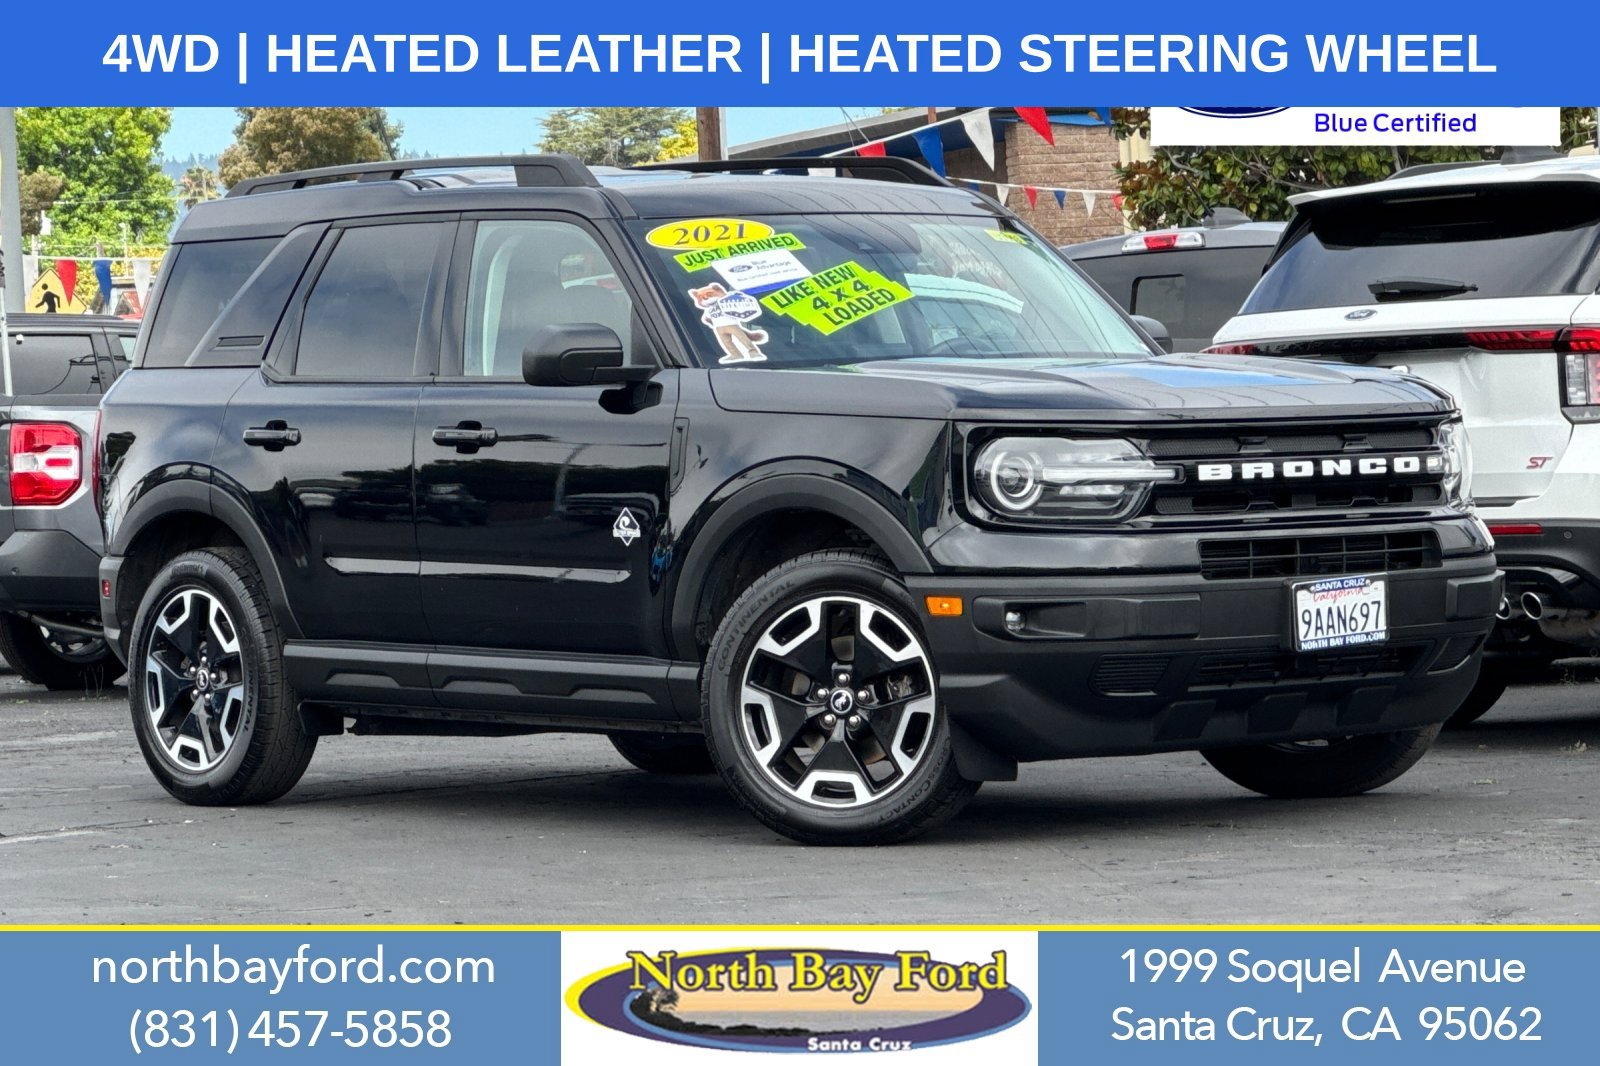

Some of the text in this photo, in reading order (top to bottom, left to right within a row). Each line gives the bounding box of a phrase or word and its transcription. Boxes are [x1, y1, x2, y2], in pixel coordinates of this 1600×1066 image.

[673, 223, 748, 246] 2021
[684, 235, 797, 267] JUST ARRIVED
[770, 281, 817, 309] LIKE
[812, 264, 857, 289] NEW
[812, 296, 832, 310] 4
[852, 279, 872, 293] 4
[823, 288, 896, 326] LOADED
[1197, 456, 1421, 481] BRONCO
[1526, 456, 1554, 470] ST
[1312, 586, 1370, 603] California
[1315, 577, 1366, 592] SANTA CRUZ
[1301, 600, 1381, 639] 9AAN697
[1301, 631, 1386, 651] NORTH BAY FORD.COM
